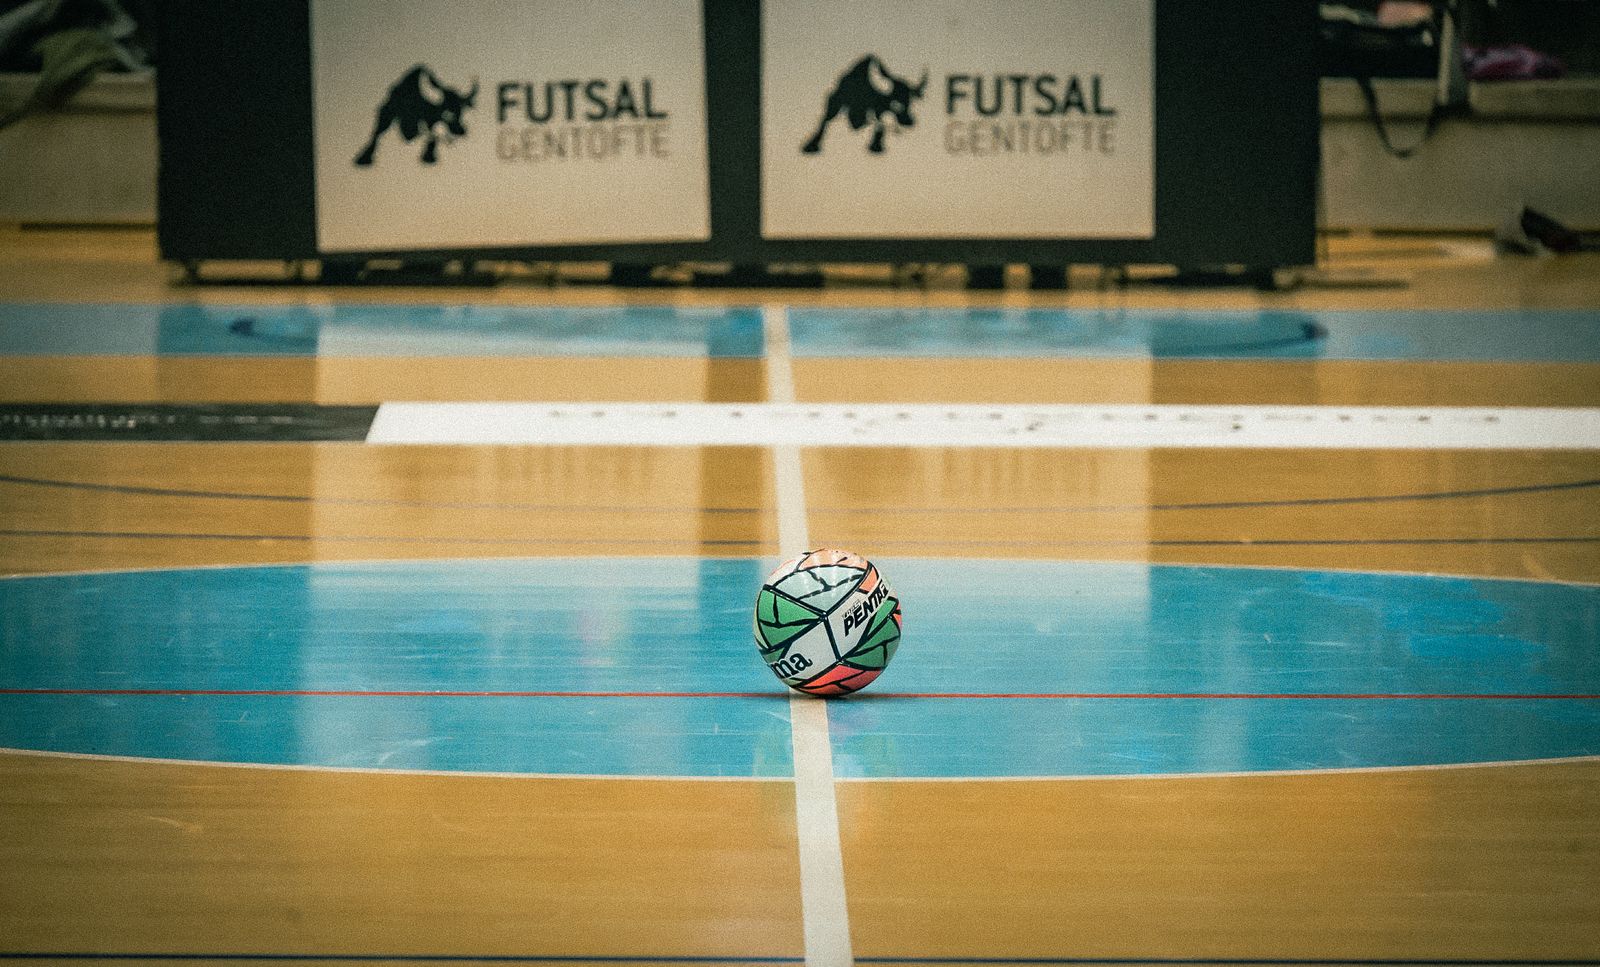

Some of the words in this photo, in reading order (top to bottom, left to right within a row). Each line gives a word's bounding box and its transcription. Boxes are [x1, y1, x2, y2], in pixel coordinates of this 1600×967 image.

[497, 78, 668, 121] FUTSAL
[946, 74, 1118, 116] FUTSAL
[496, 123, 670, 162] GENTOFTE
[945, 119, 1117, 156] GENTOFTE
